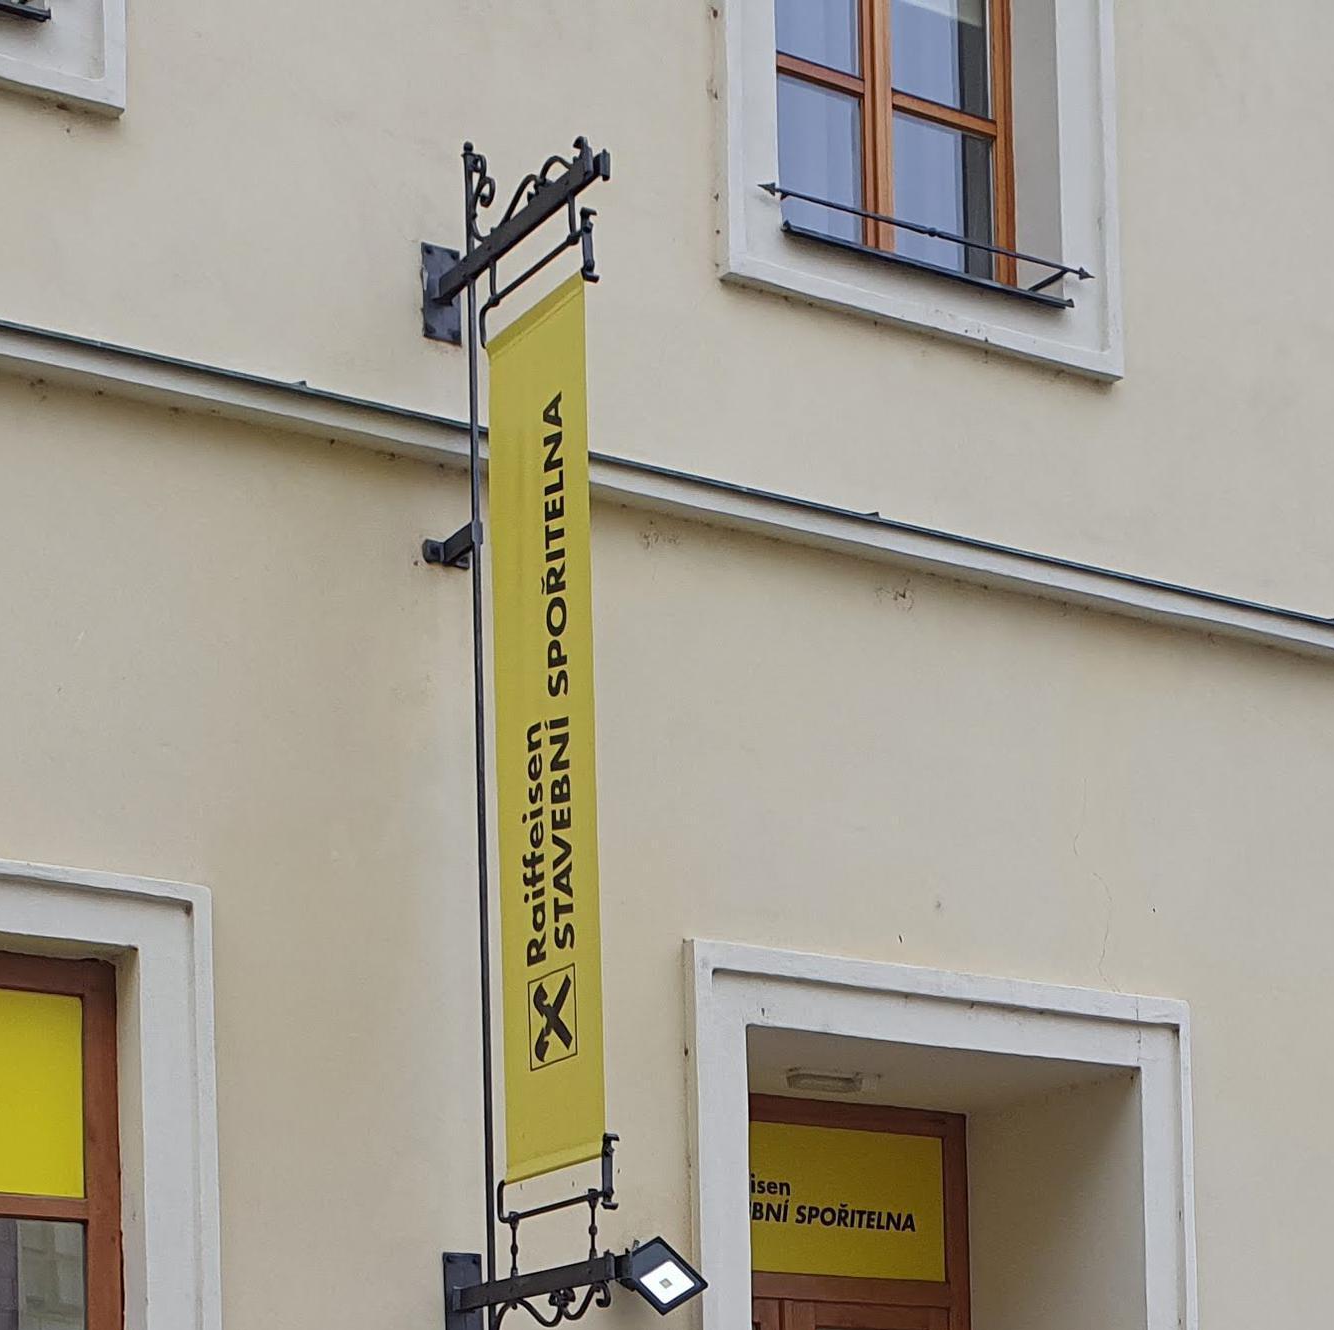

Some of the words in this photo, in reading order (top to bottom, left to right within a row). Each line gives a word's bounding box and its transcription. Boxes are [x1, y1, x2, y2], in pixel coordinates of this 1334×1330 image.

[541, 390, 569, 697] SPOŘITELNA
[522, 721, 547, 967] Raiffeisen
[545, 716, 575, 950] STAVEBNÍ
[750, 1173, 791, 1196] isen
[750, 1200, 790, 1223] BNÍ
[795, 1203, 916, 1233] SPOŘITELNA
